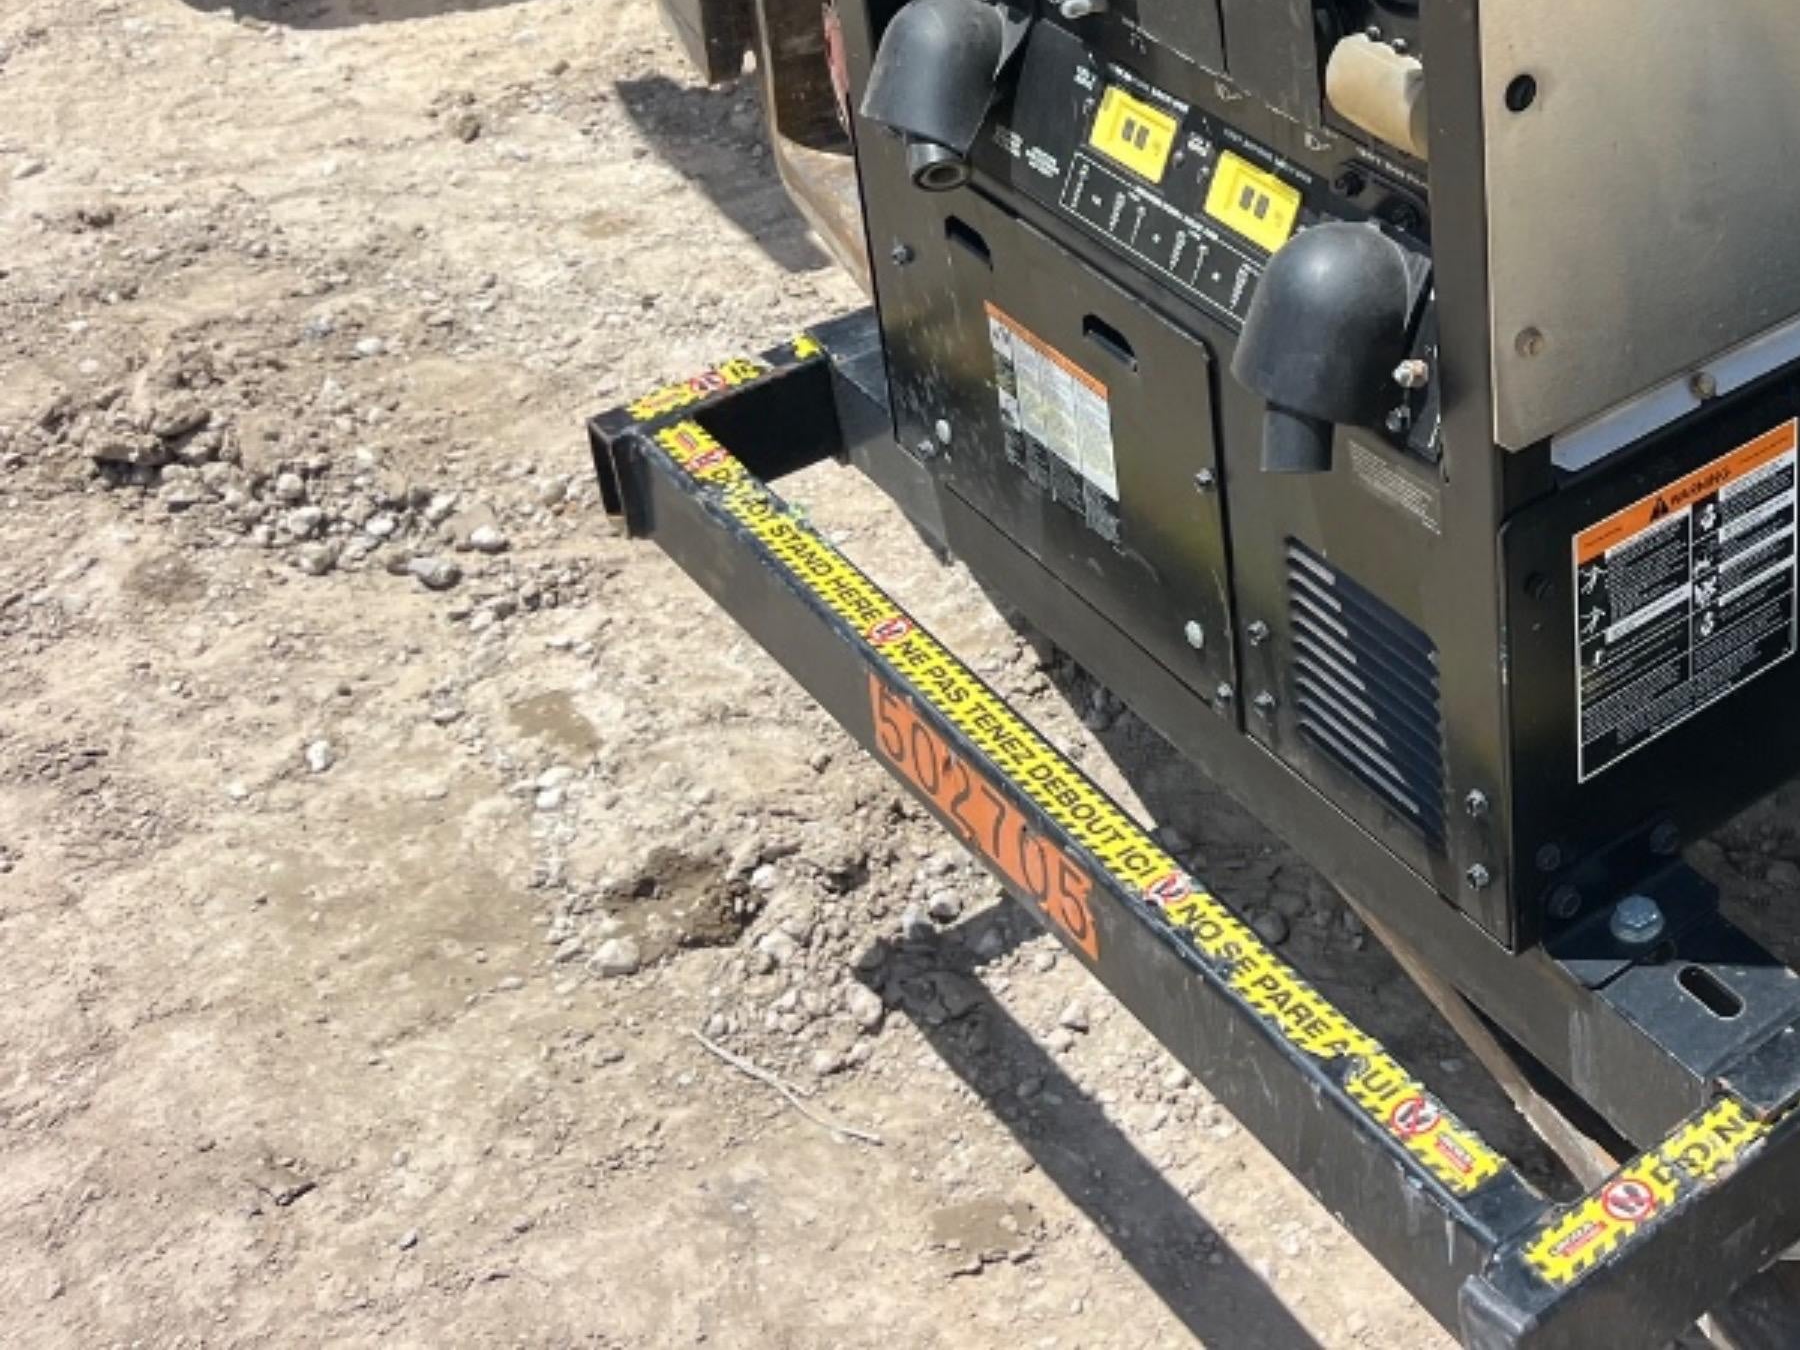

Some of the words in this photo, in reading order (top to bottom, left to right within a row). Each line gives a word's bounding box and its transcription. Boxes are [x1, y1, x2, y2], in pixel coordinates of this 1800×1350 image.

[769, 522, 835, 577] STAND
[827, 574, 884, 622] HERE
[899, 637, 933, 667] NE
[927, 664, 970, 703] PAS
[968, 701, 1036, 766] TENEZ
[1029, 763, 1127, 851] DEBOUT
[1119, 847, 1158, 878] ICI
[1176, 901, 1226, 944] NO
[1219, 941, 1256, 974] SE
[1252, 973, 1331, 1039] PARE
